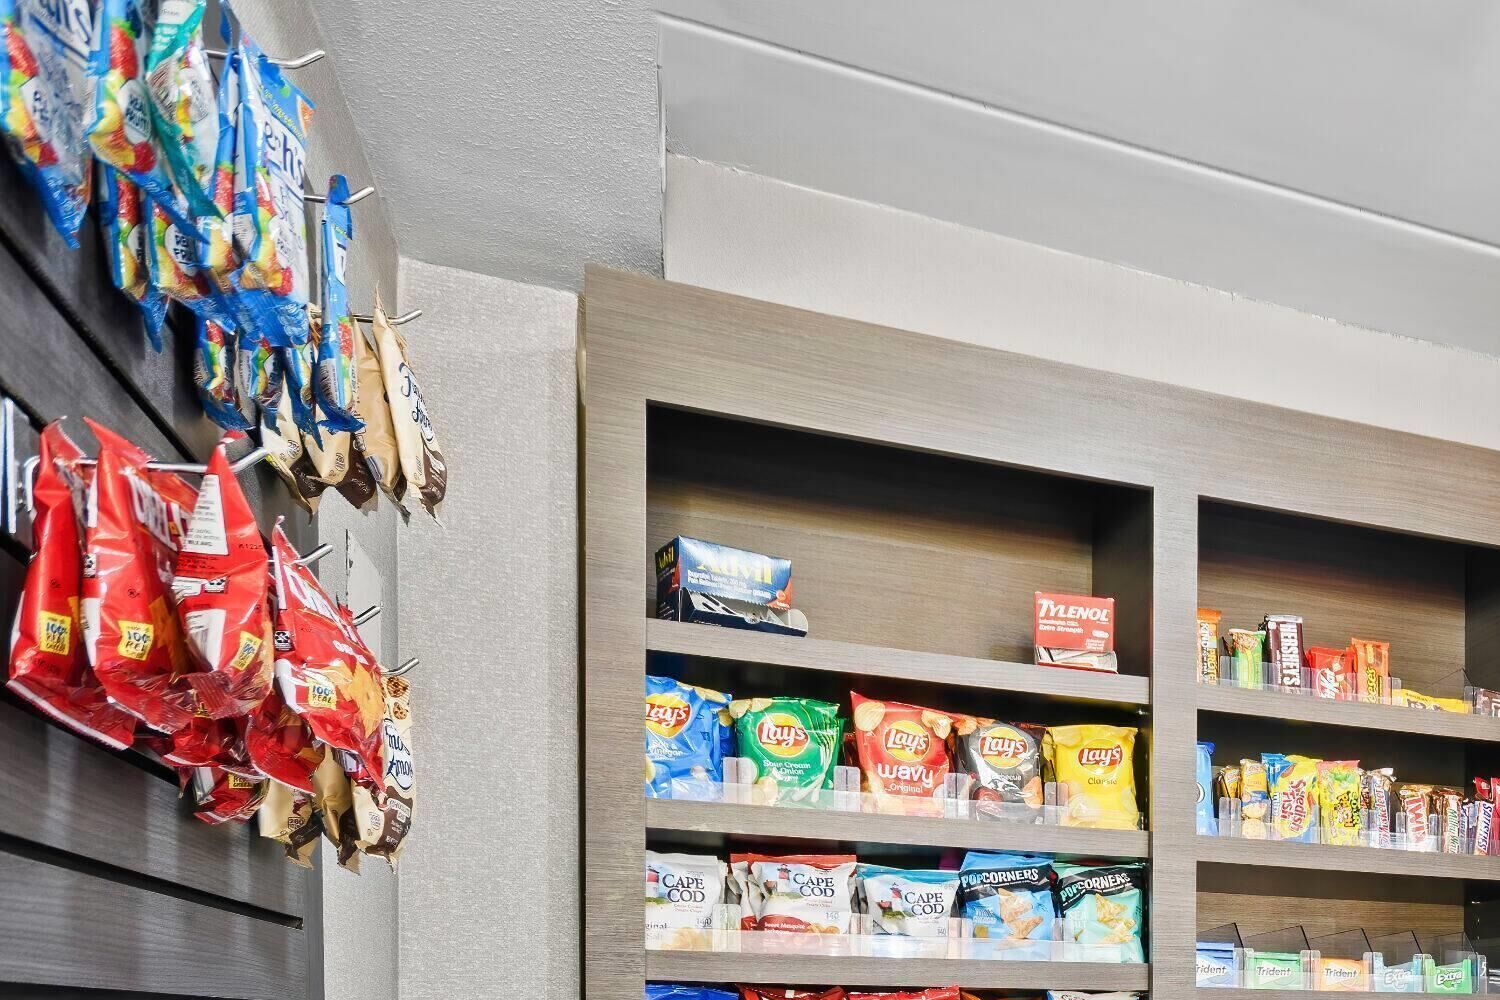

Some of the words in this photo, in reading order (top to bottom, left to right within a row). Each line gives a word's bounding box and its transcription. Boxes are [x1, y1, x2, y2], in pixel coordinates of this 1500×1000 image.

[1037, 598, 1110, 622] TYLENOL
[1279, 622, 1300, 687] HERSHEY'S
[311, 695, 333, 704] REAL
[759, 718, 807, 747] Lay's
[885, 728, 929, 754] Lay's
[980, 734, 1029, 759] Lay's
[783, 761, 812, 770] Cream
[1080, 745, 1122, 768] Lay's
[876, 762, 935, 786] wavy
[889, 783, 924, 795] Original
[1280, 790, 1293, 820] Fish
[1290, 778, 1307, 833] Swedish
[1404, 793, 1429, 842] TWIX
[662, 872, 706, 890] CAPE
[792, 872, 835, 888] CAPE
[960, 868, 1040, 889] POPCORNERS
[1059, 871, 1132, 901] POPCORNERS
[666, 887, 706, 904] COD
[799, 885, 835, 898] COD
[903, 891, 945, 905] CAPE
[910, 902, 945, 917] COD
[1256, 966, 1292, 977] Trident
[1324, 967, 1358, 978] Trident
[1437, 968, 1464, 984] Extra
